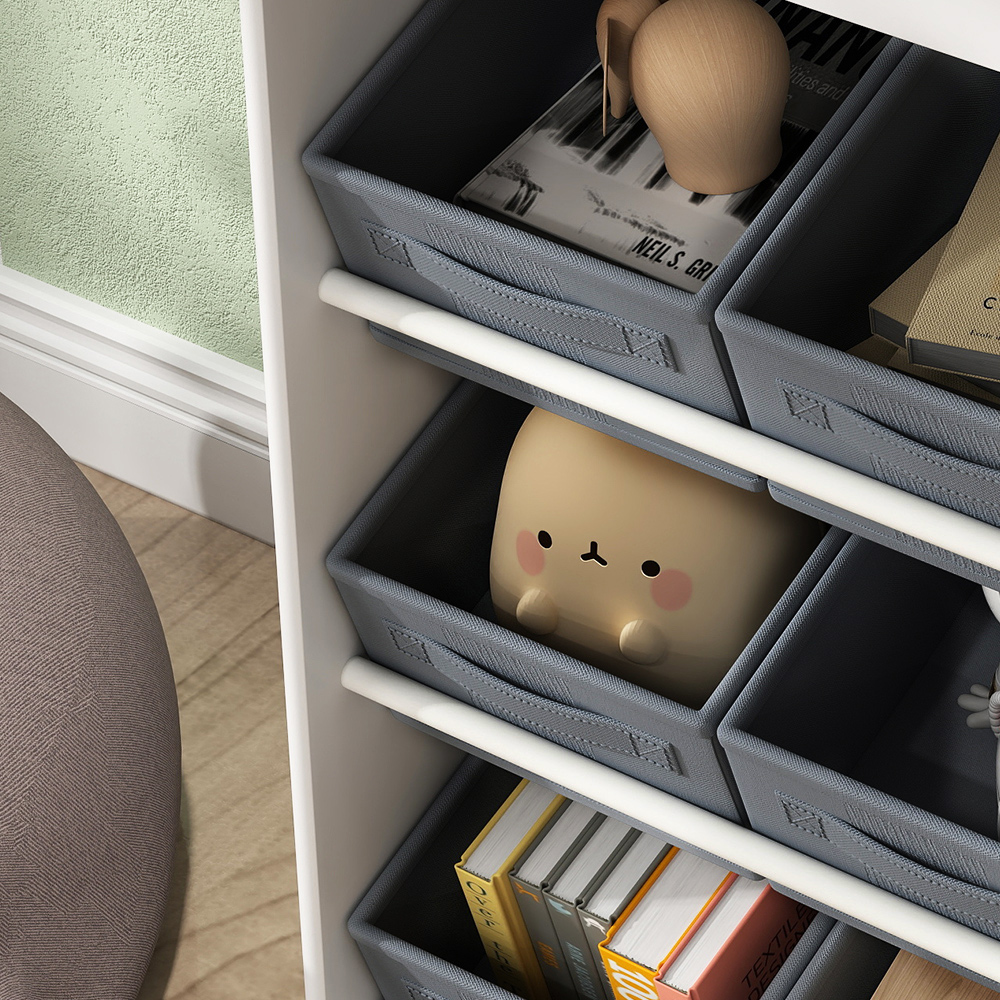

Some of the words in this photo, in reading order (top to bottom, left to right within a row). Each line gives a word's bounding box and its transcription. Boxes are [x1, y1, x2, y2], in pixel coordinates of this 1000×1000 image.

[631, 235, 673, 263] NEIL
[666, 250, 686, 270] S.
[741, 903, 808, 989] TEXTILE
